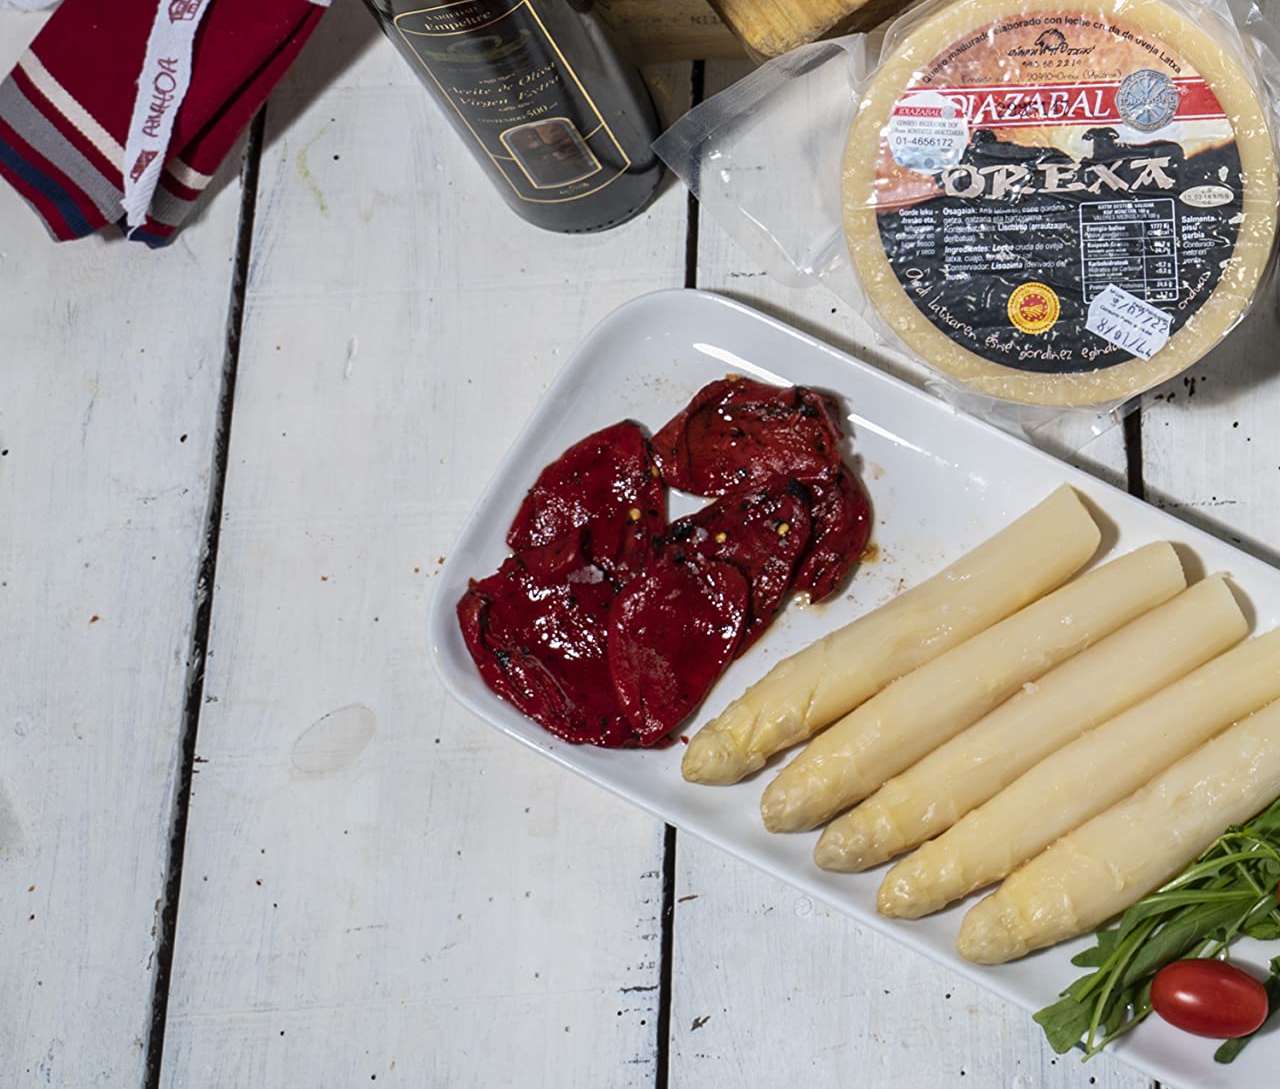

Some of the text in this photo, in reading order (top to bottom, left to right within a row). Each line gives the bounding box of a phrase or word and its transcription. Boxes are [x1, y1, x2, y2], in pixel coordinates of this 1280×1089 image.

[922, 58, 948, 84] Queso
[948, 30, 991, 61] madurad
[993, 17, 1041, 36] elaborado
[1044, 16, 1063, 25] con
[1065, 16, 1091, 27] leche
[1093, 19, 1120, 36] crda
[1122, 30, 1134, 41] de
[1135, 37, 1159, 56] oveja
[1158, 51, 1183, 74] Latxa
[945, 89, 1112, 123] DIAZABAL
[896, 137, 954, 147] 01-4656172
[941, 157, 1176, 200] OREXA
[899, 208, 919, 217] Gorde
[1182, 224, 1198, 232] pisu
[1182, 231, 1205, 241] garbia
[944, 245, 991, 255] Ingredientes:
[992, 243, 1015, 252] Leche
[1015, 243, 1034, 251] cruda
[1045, 242, 1064, 251] oveja
[991, 262, 1023, 270] Lisozima
